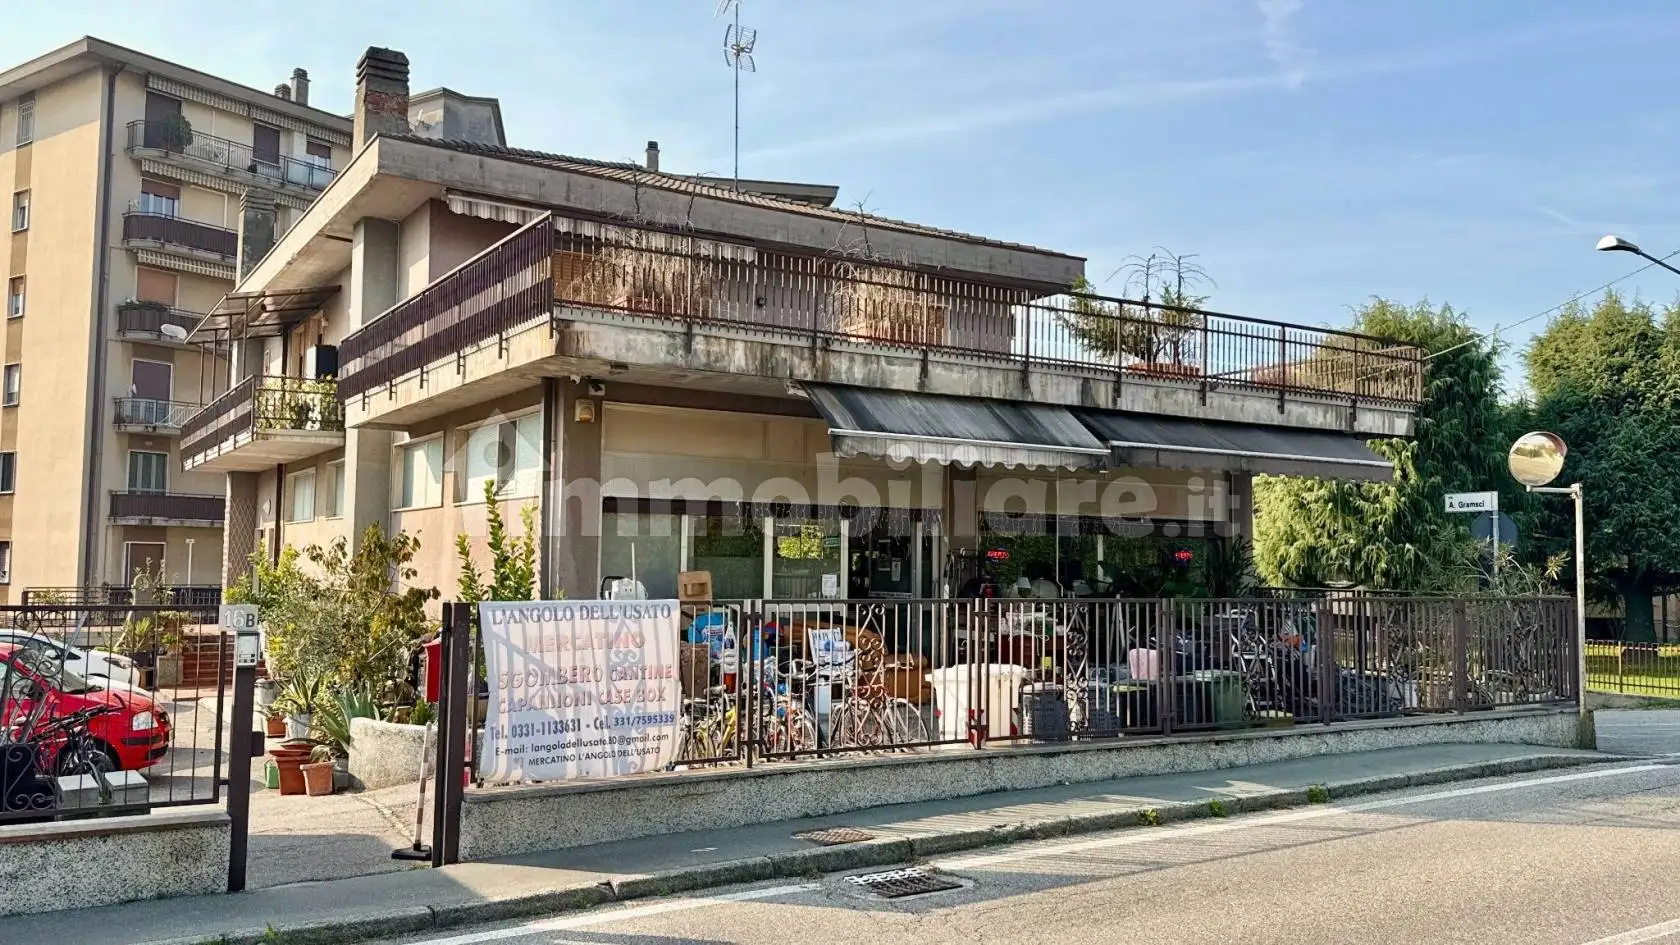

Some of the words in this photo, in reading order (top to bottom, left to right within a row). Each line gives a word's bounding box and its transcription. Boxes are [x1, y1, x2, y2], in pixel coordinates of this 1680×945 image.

[1458, 500, 1484, 508] Gramsci
[492, 606, 575, 625] L'ANGOLO
[579, 604, 672, 621] DELL'USATO
[498, 666, 603, 689] SGOMBERO
[611, 664, 673, 682] CANTINE
[599, 688, 631, 706] CASE
[490, 724, 508, 740] Tel.
[511, 718, 581, 738] 0331-1133631
[594, 715, 611, 730] Cel.
[614, 714, 675, 727] 331/7595339
[495, 745, 528, 756] E-mail:
[528, 753, 576, 766] MERCATINO
[578, 750, 616, 760] L'ANGOLO
[617, 747, 660, 758] DELL'USATO
